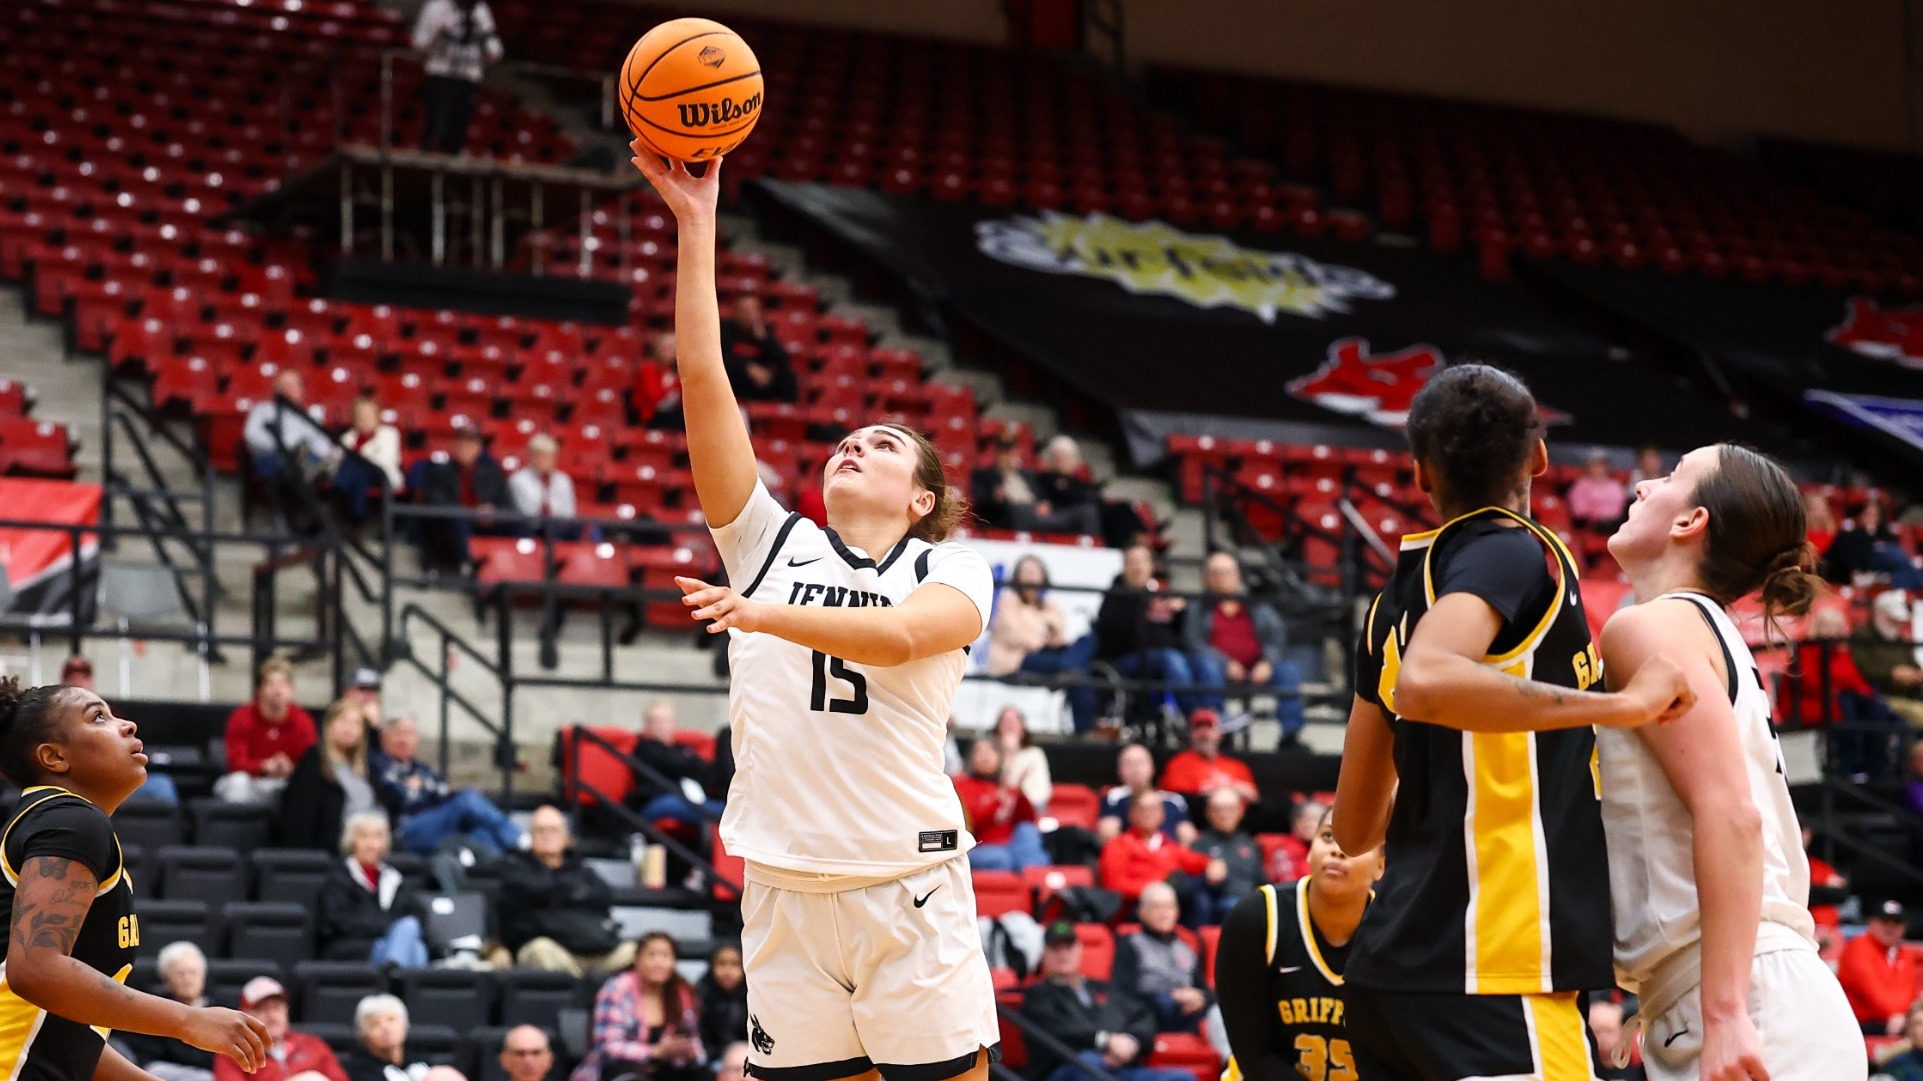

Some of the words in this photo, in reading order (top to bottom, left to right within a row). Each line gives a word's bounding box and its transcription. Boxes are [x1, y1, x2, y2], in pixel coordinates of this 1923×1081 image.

[677, 91, 760, 127] Wilson
[810, 648, 869, 715] 15
[946, 836, 952, 845] L
[1294, 1032, 1359, 1081] 35
